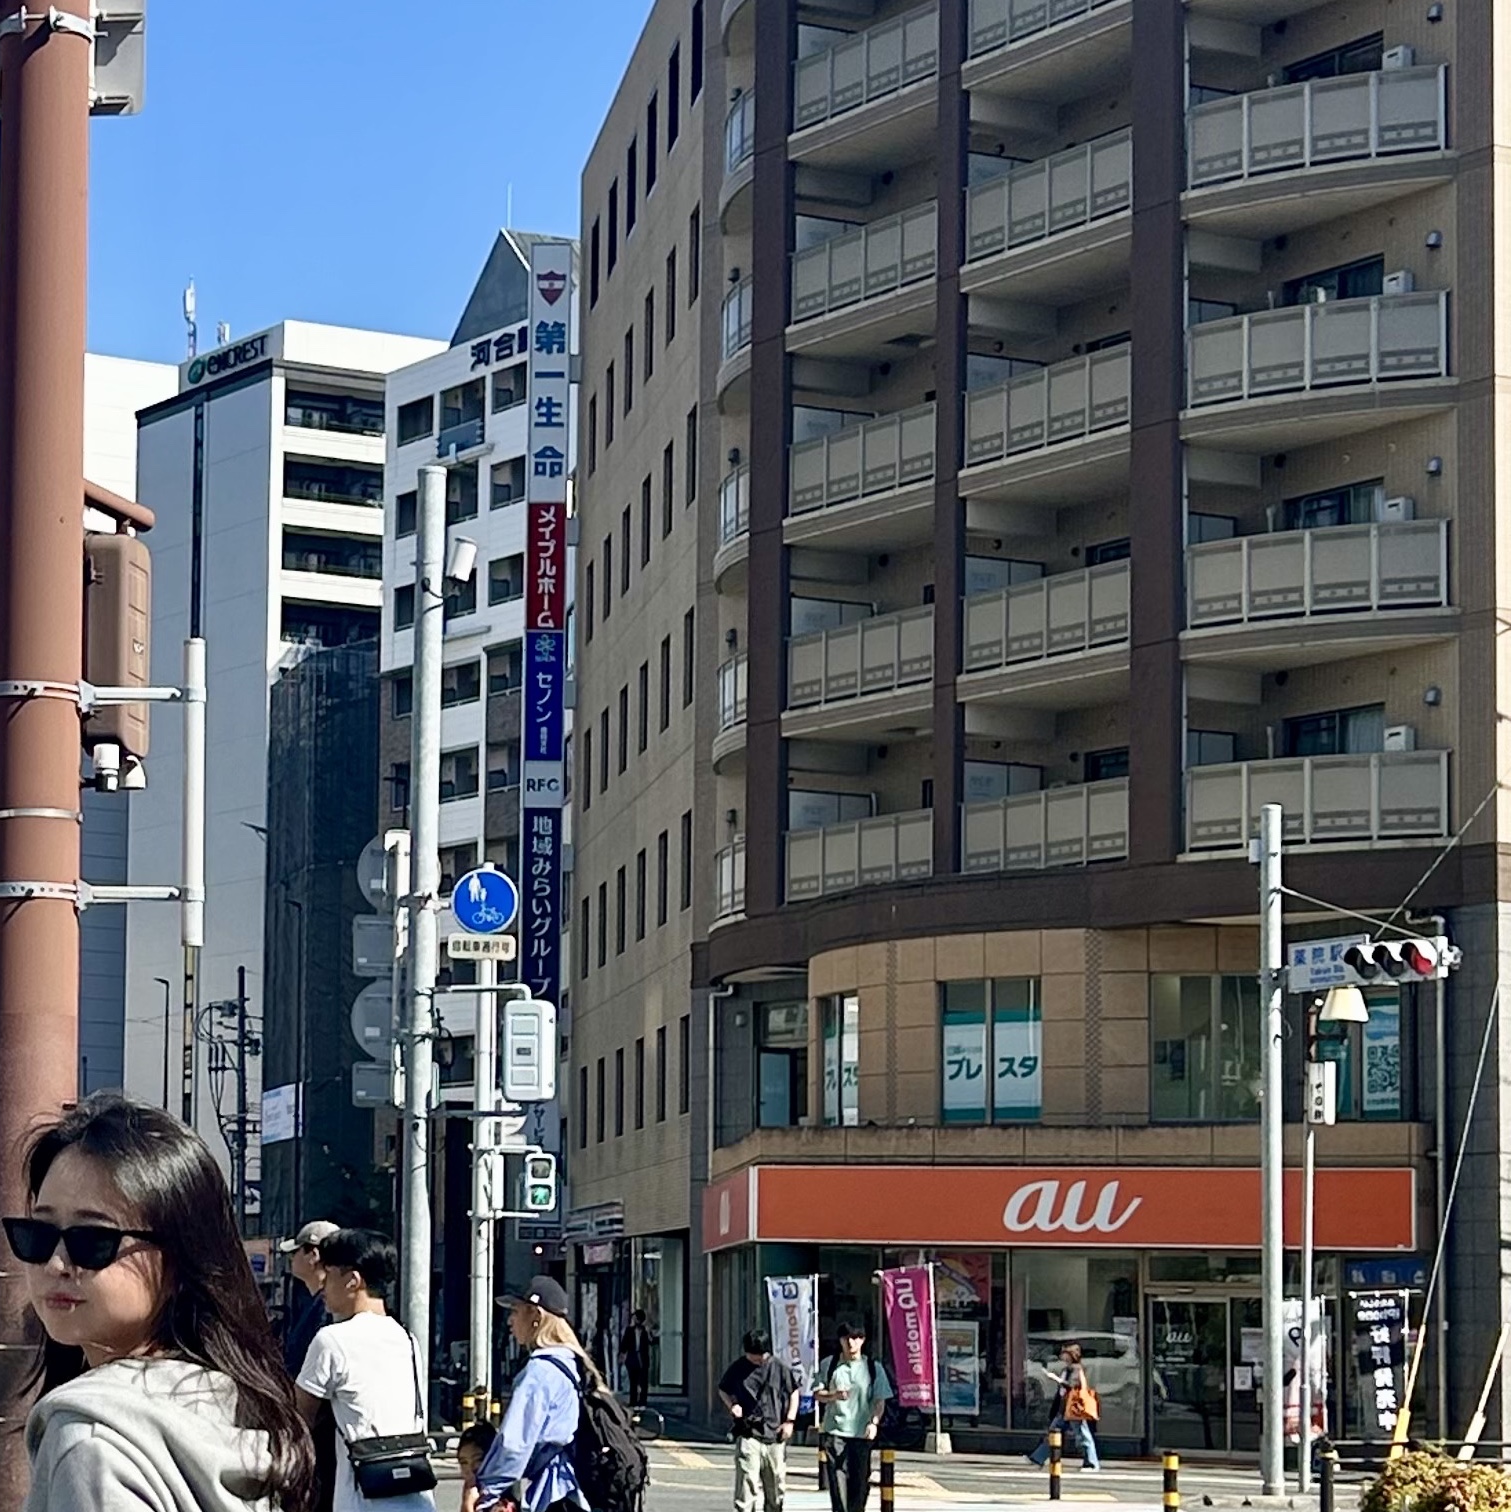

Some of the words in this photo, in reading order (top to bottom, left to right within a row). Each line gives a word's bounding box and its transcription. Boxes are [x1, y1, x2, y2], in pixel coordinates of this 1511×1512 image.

[533, 320, 567, 478] 第一生命
[537, 505, 556, 628] メイプルホーム
[536, 671, 552, 723] セノン
[531, 816, 552, 997] 地域みらいグループ
[1003, 1179, 1143, 1233] au
